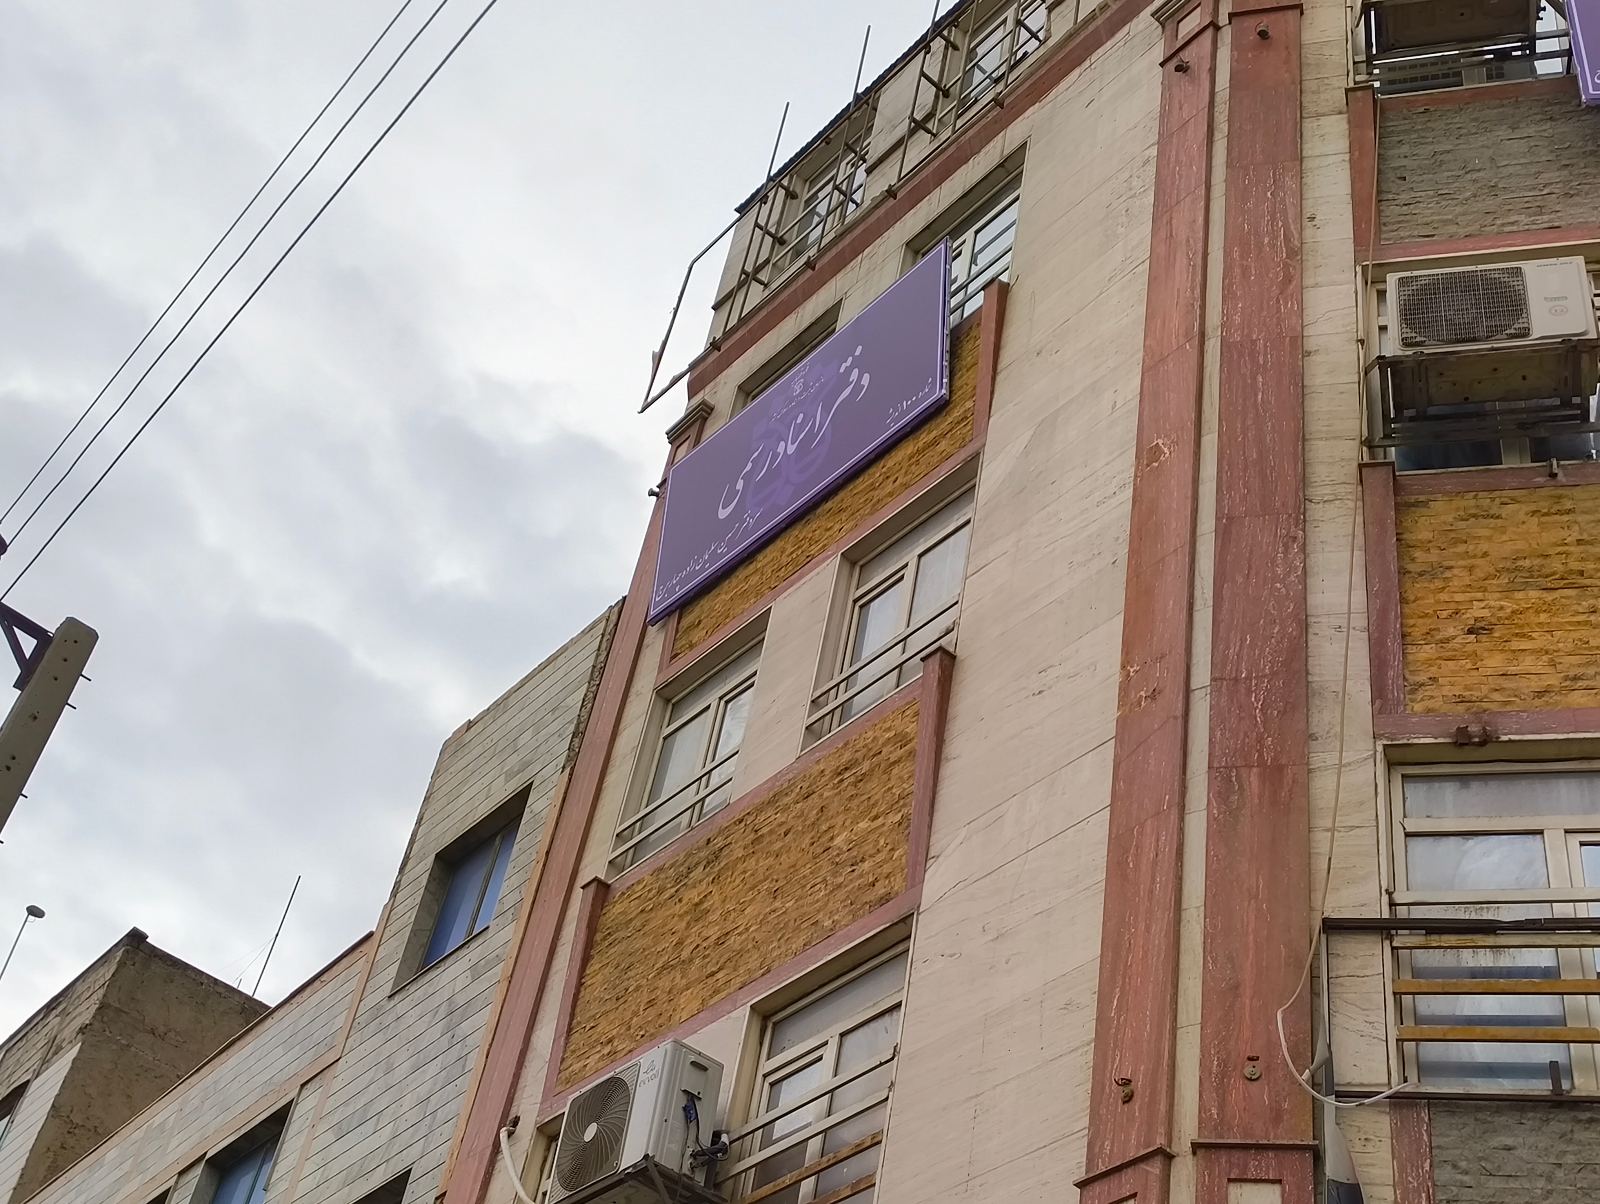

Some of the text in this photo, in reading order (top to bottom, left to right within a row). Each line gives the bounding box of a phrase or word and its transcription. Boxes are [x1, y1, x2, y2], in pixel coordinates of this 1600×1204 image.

[811, 345, 870, 449] دفتر
[772, 401, 823, 469] اسناد
[717, 443, 773, 520] رسمی
[717, 522, 740, 553] حسین
